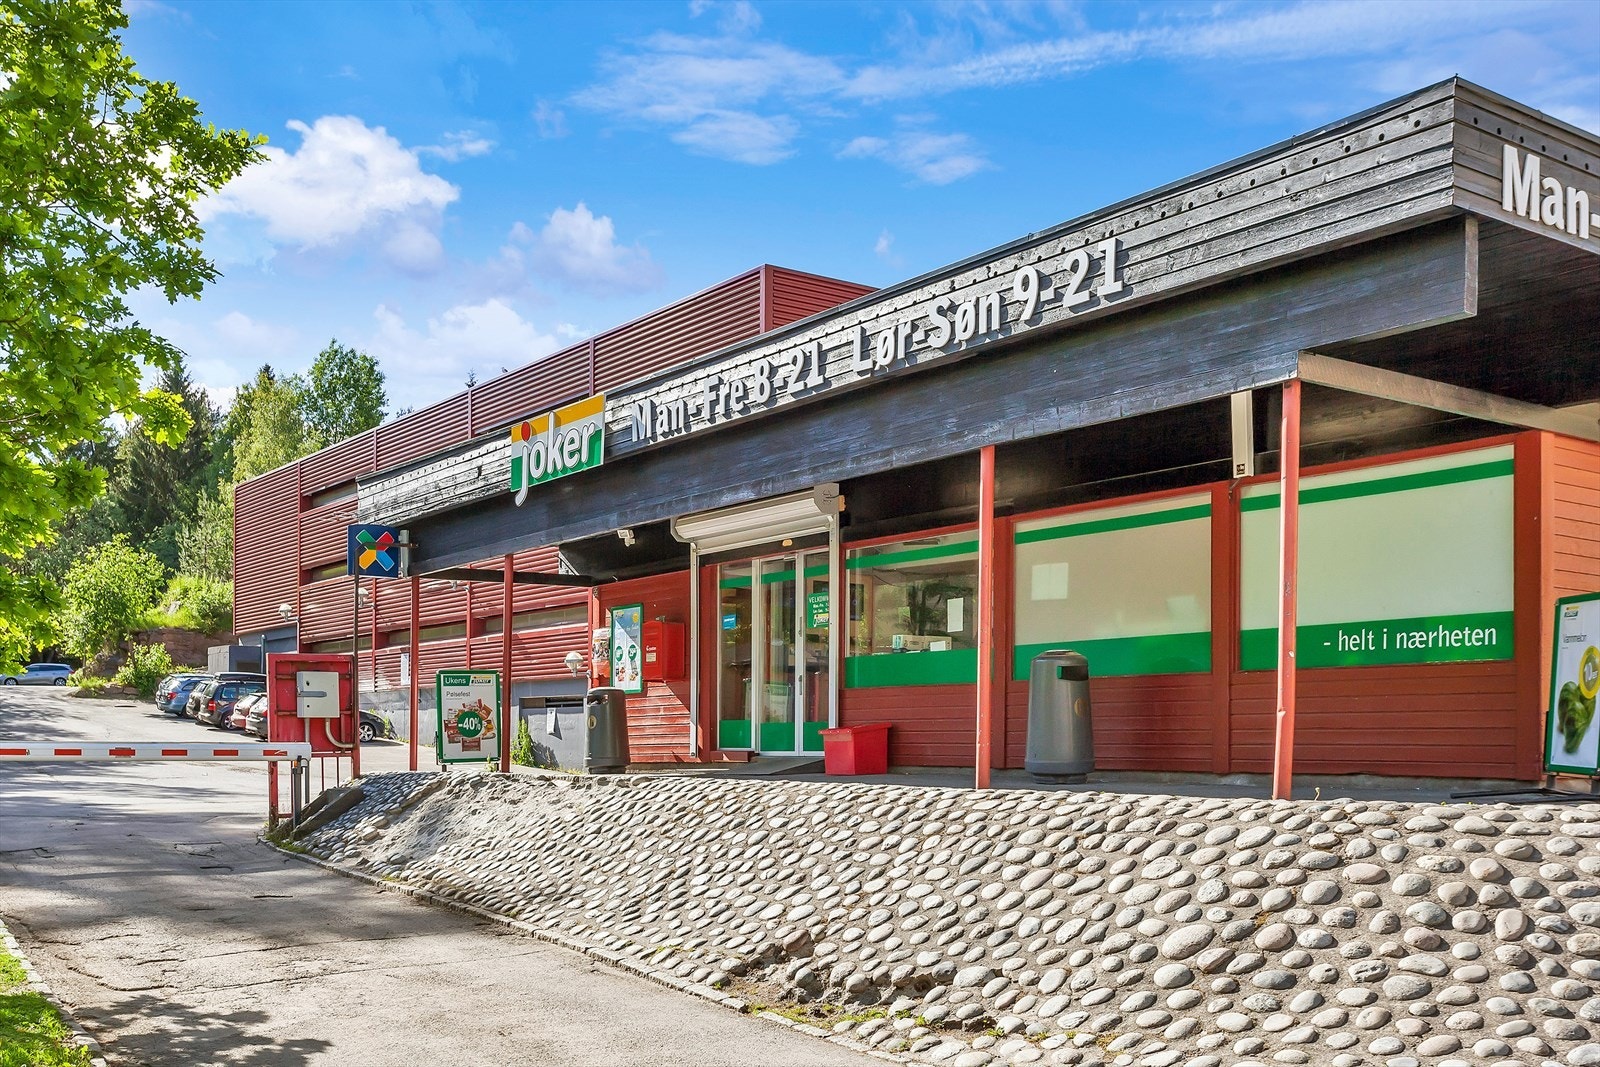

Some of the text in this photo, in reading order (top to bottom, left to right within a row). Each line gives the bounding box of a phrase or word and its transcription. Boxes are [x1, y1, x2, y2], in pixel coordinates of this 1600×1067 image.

[1502, 144, 1600, 240] Man-
[750, 341, 824, 404] 8-21
[852, 292, 1001, 372] Lør-Søn
[1013, 238, 1124, 321] 9-21
[514, 411, 596, 507] joker
[1338, 628, 1375, 652] helt
[1382, 628, 1388, 650] i
[1395, 625, 1497, 650] nærheten
[458, 717, 481, 731] -40%
